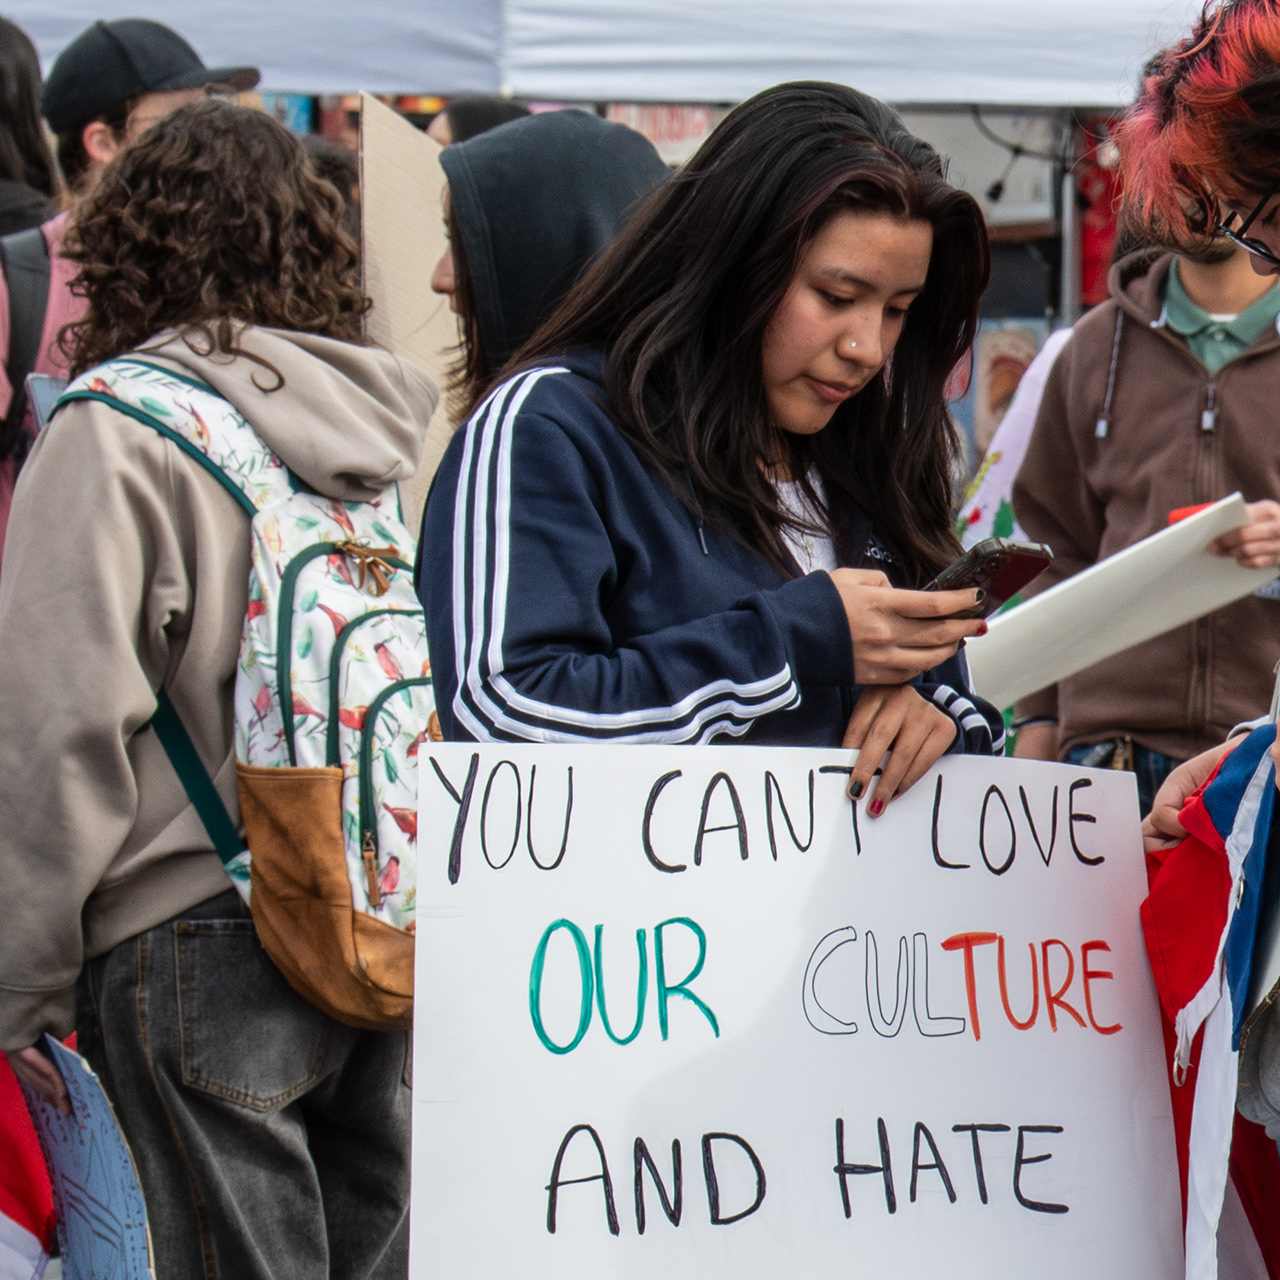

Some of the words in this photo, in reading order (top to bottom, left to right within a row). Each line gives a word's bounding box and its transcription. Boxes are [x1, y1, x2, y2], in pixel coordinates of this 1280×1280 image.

[429, 752, 573, 885] YOU
[931, 774, 1105, 876] LOVE
[529, 917, 720, 1055] OUR
[802, 925, 1123, 1042] CULTURE
[545, 1123, 767, 1237] AND
[833, 1117, 1070, 1219] HATE
